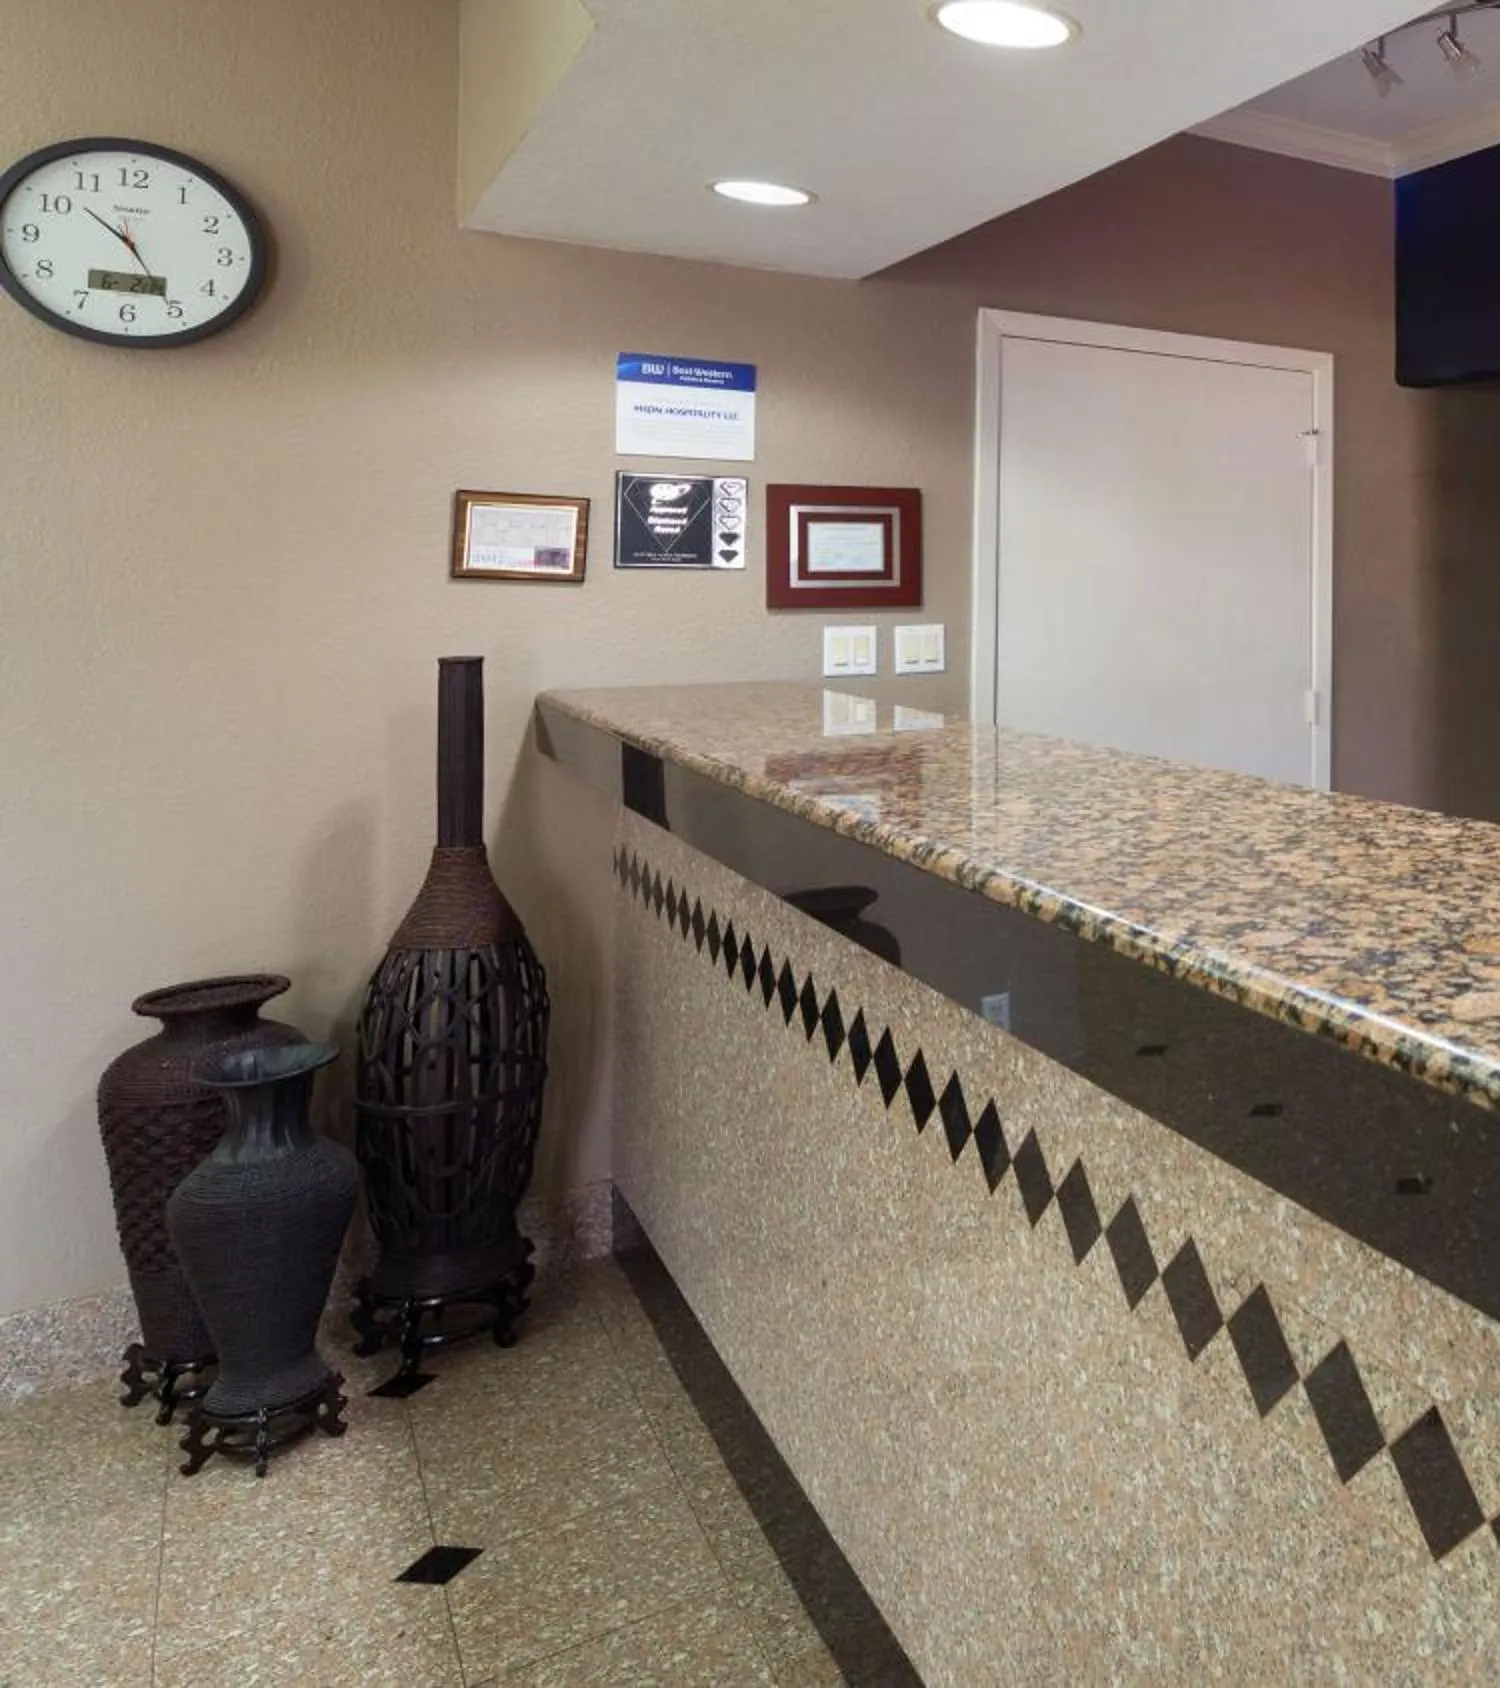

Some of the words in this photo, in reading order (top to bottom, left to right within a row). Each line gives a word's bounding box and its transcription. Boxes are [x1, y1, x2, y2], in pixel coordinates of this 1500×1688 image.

[74, 171, 102, 193] 11
[117, 167, 150, 189] 12
[39, 193, 72, 214] 10
[178, 186, 189, 205] 1
[22, 224, 40, 243] 9
[202, 215, 219, 235] 2
[217, 247, 233, 267] 3
[35, 259, 54, 279] 8
[200, 279, 216, 297] 4
[73, 289, 90, 309] 7
[166, 299, 184, 319] 5
[119, 304, 136, 323] 6
